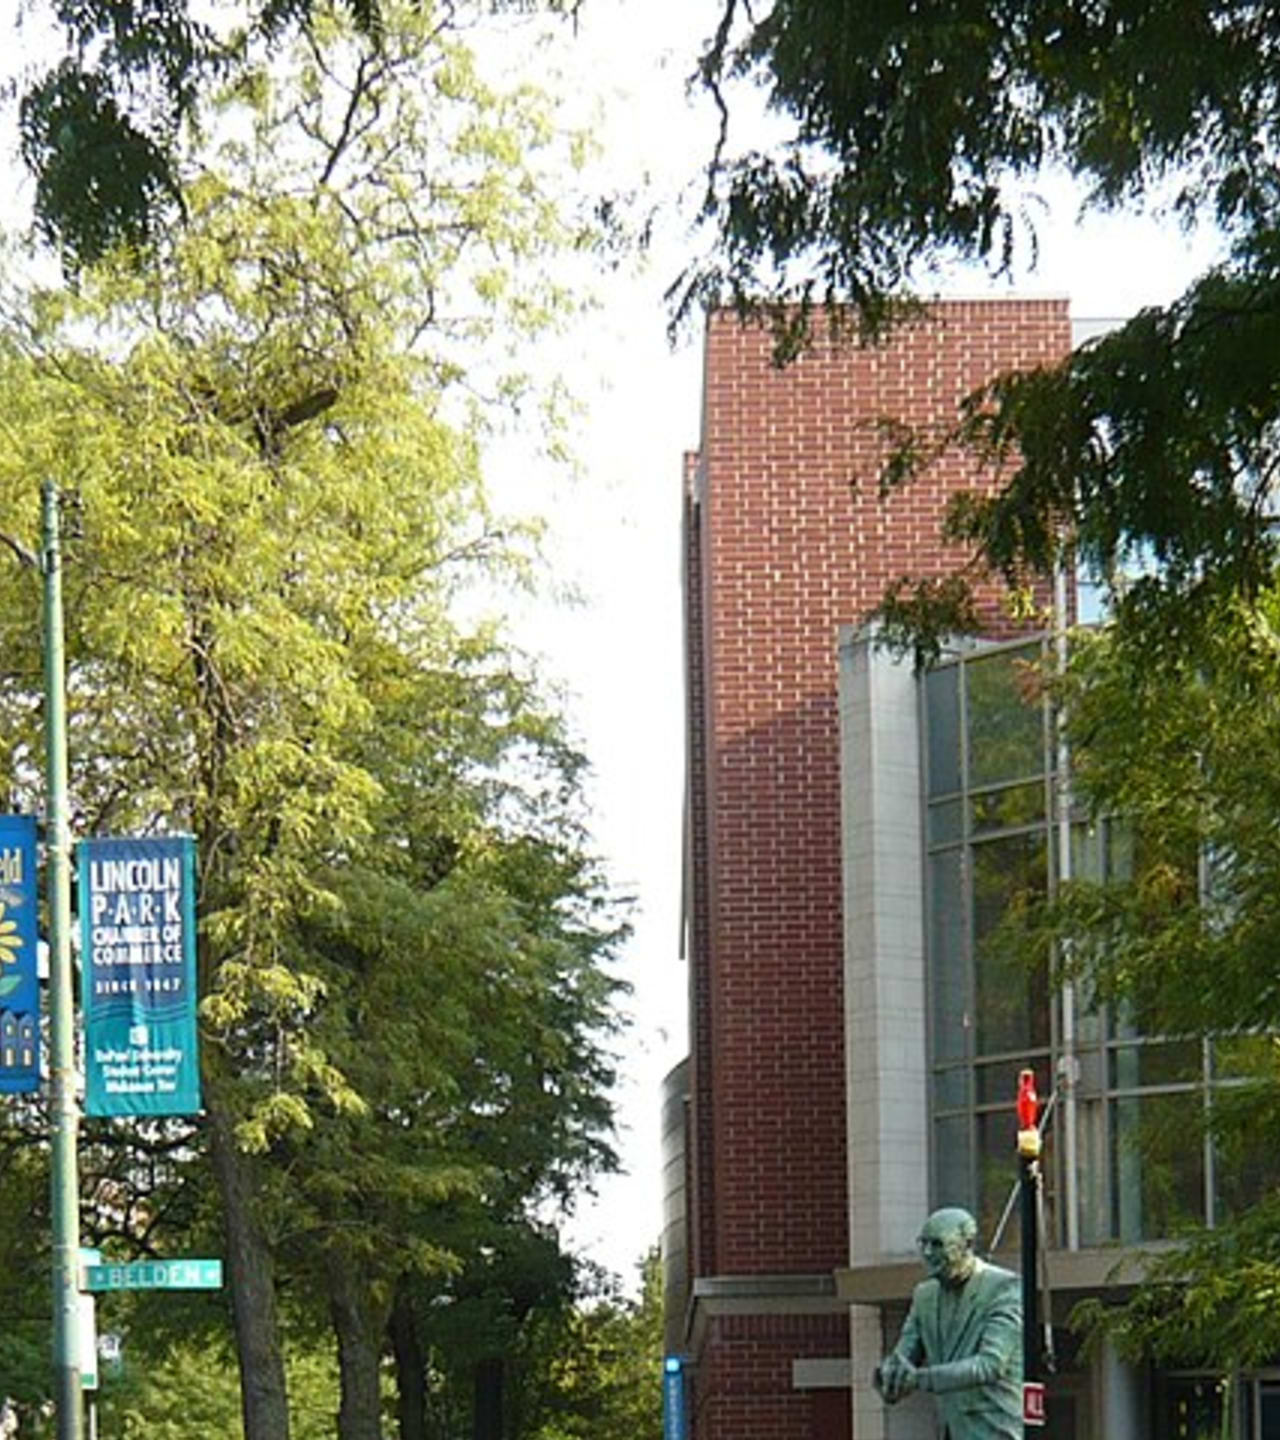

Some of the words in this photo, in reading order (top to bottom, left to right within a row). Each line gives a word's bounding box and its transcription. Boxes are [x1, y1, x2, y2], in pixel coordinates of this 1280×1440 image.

[91, 858, 180, 892] LINCOLN
[92, 926, 160, 946] CHAMBER
[162, 922, 181, 944] OF
[93, 944, 182, 965] COMMERCE
[110, 1262, 202, 1285] BELDEN
